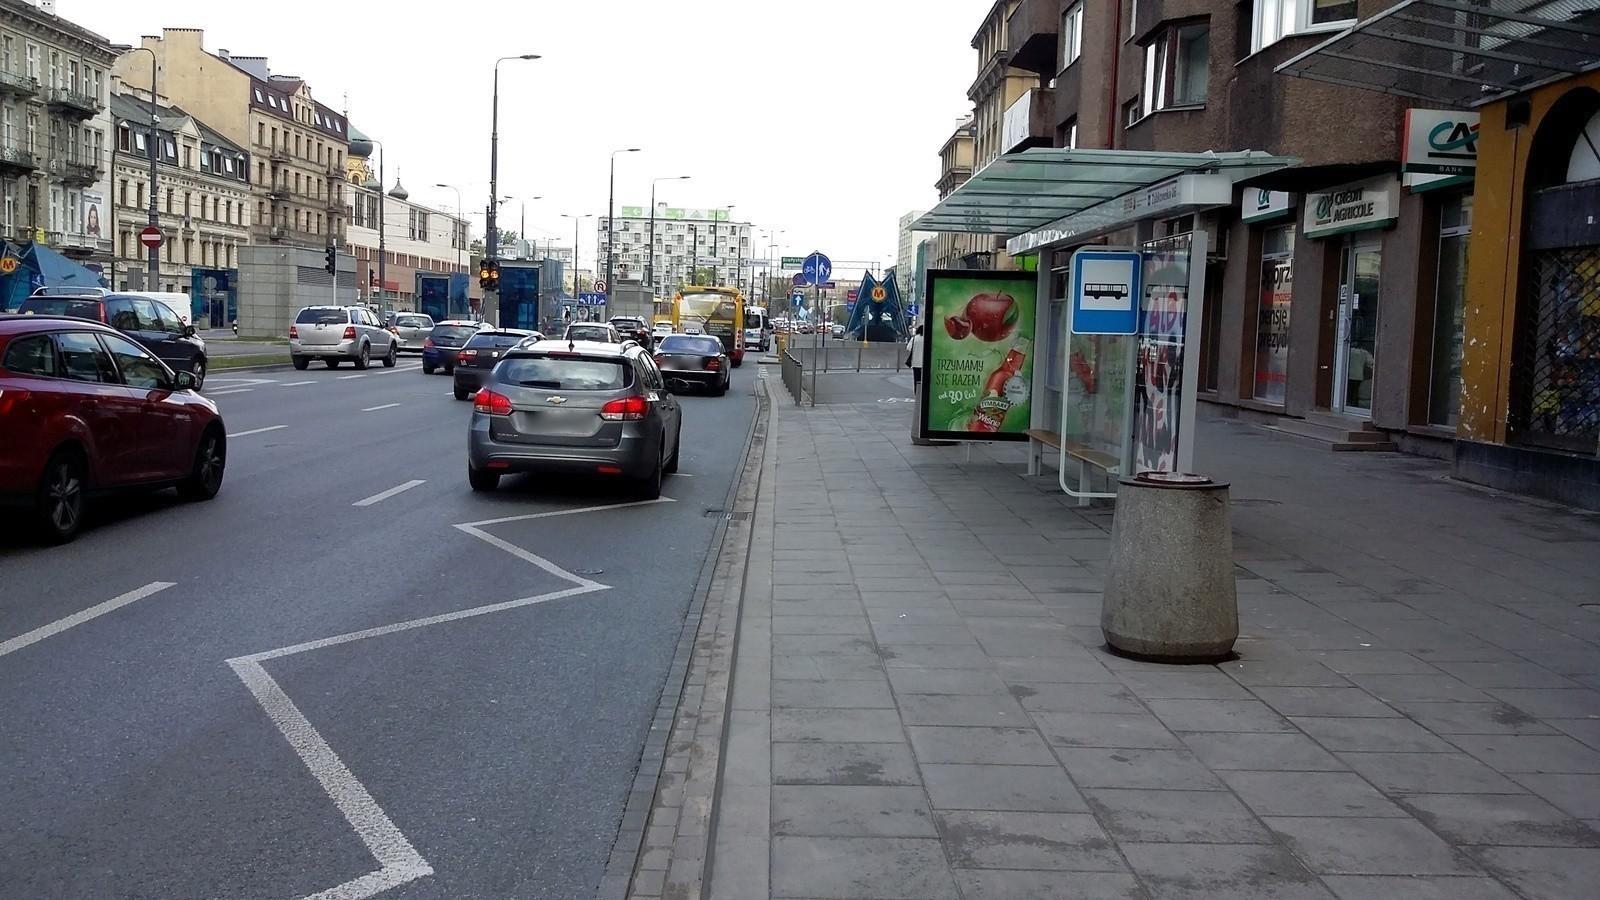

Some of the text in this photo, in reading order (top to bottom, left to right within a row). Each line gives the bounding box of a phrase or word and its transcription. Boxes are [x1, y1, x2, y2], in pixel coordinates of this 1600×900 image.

[1438, 165, 1463, 173] BANK
[1333, 202, 1374, 222] AGRICOLE
[873, 289, 884, 298] M
[937, 359, 984, 371] TRZYMAMY
[936, 374, 980, 387] SIĘ RAZEM
[949, 390, 962, 404] 80
[964, 389, 976, 399] lat
